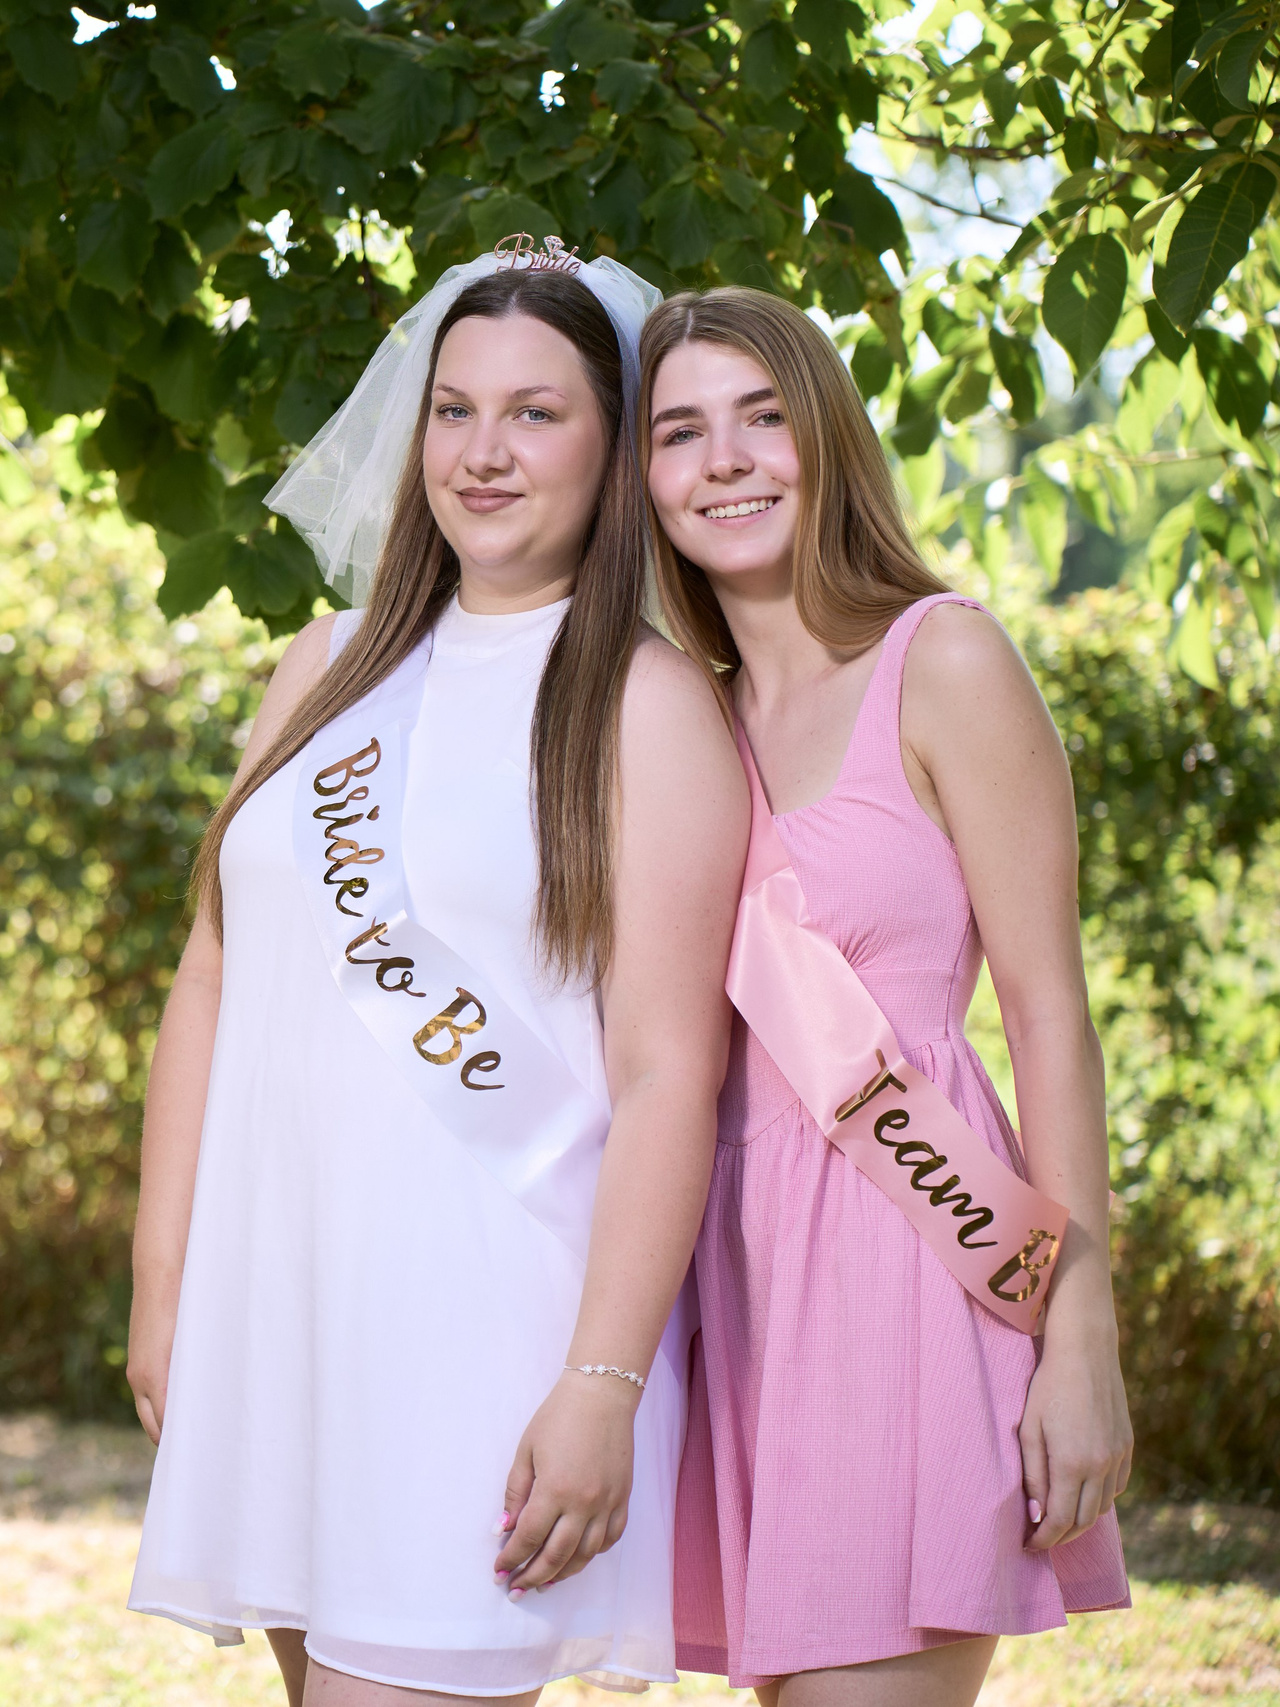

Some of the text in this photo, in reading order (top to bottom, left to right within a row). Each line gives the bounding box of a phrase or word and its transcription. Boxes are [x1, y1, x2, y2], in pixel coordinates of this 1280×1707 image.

[494, 231, 581, 275] Bride
[313, 736, 506, 1091] Bride to Be
[834, 1048, 1060, 1320] Team B
